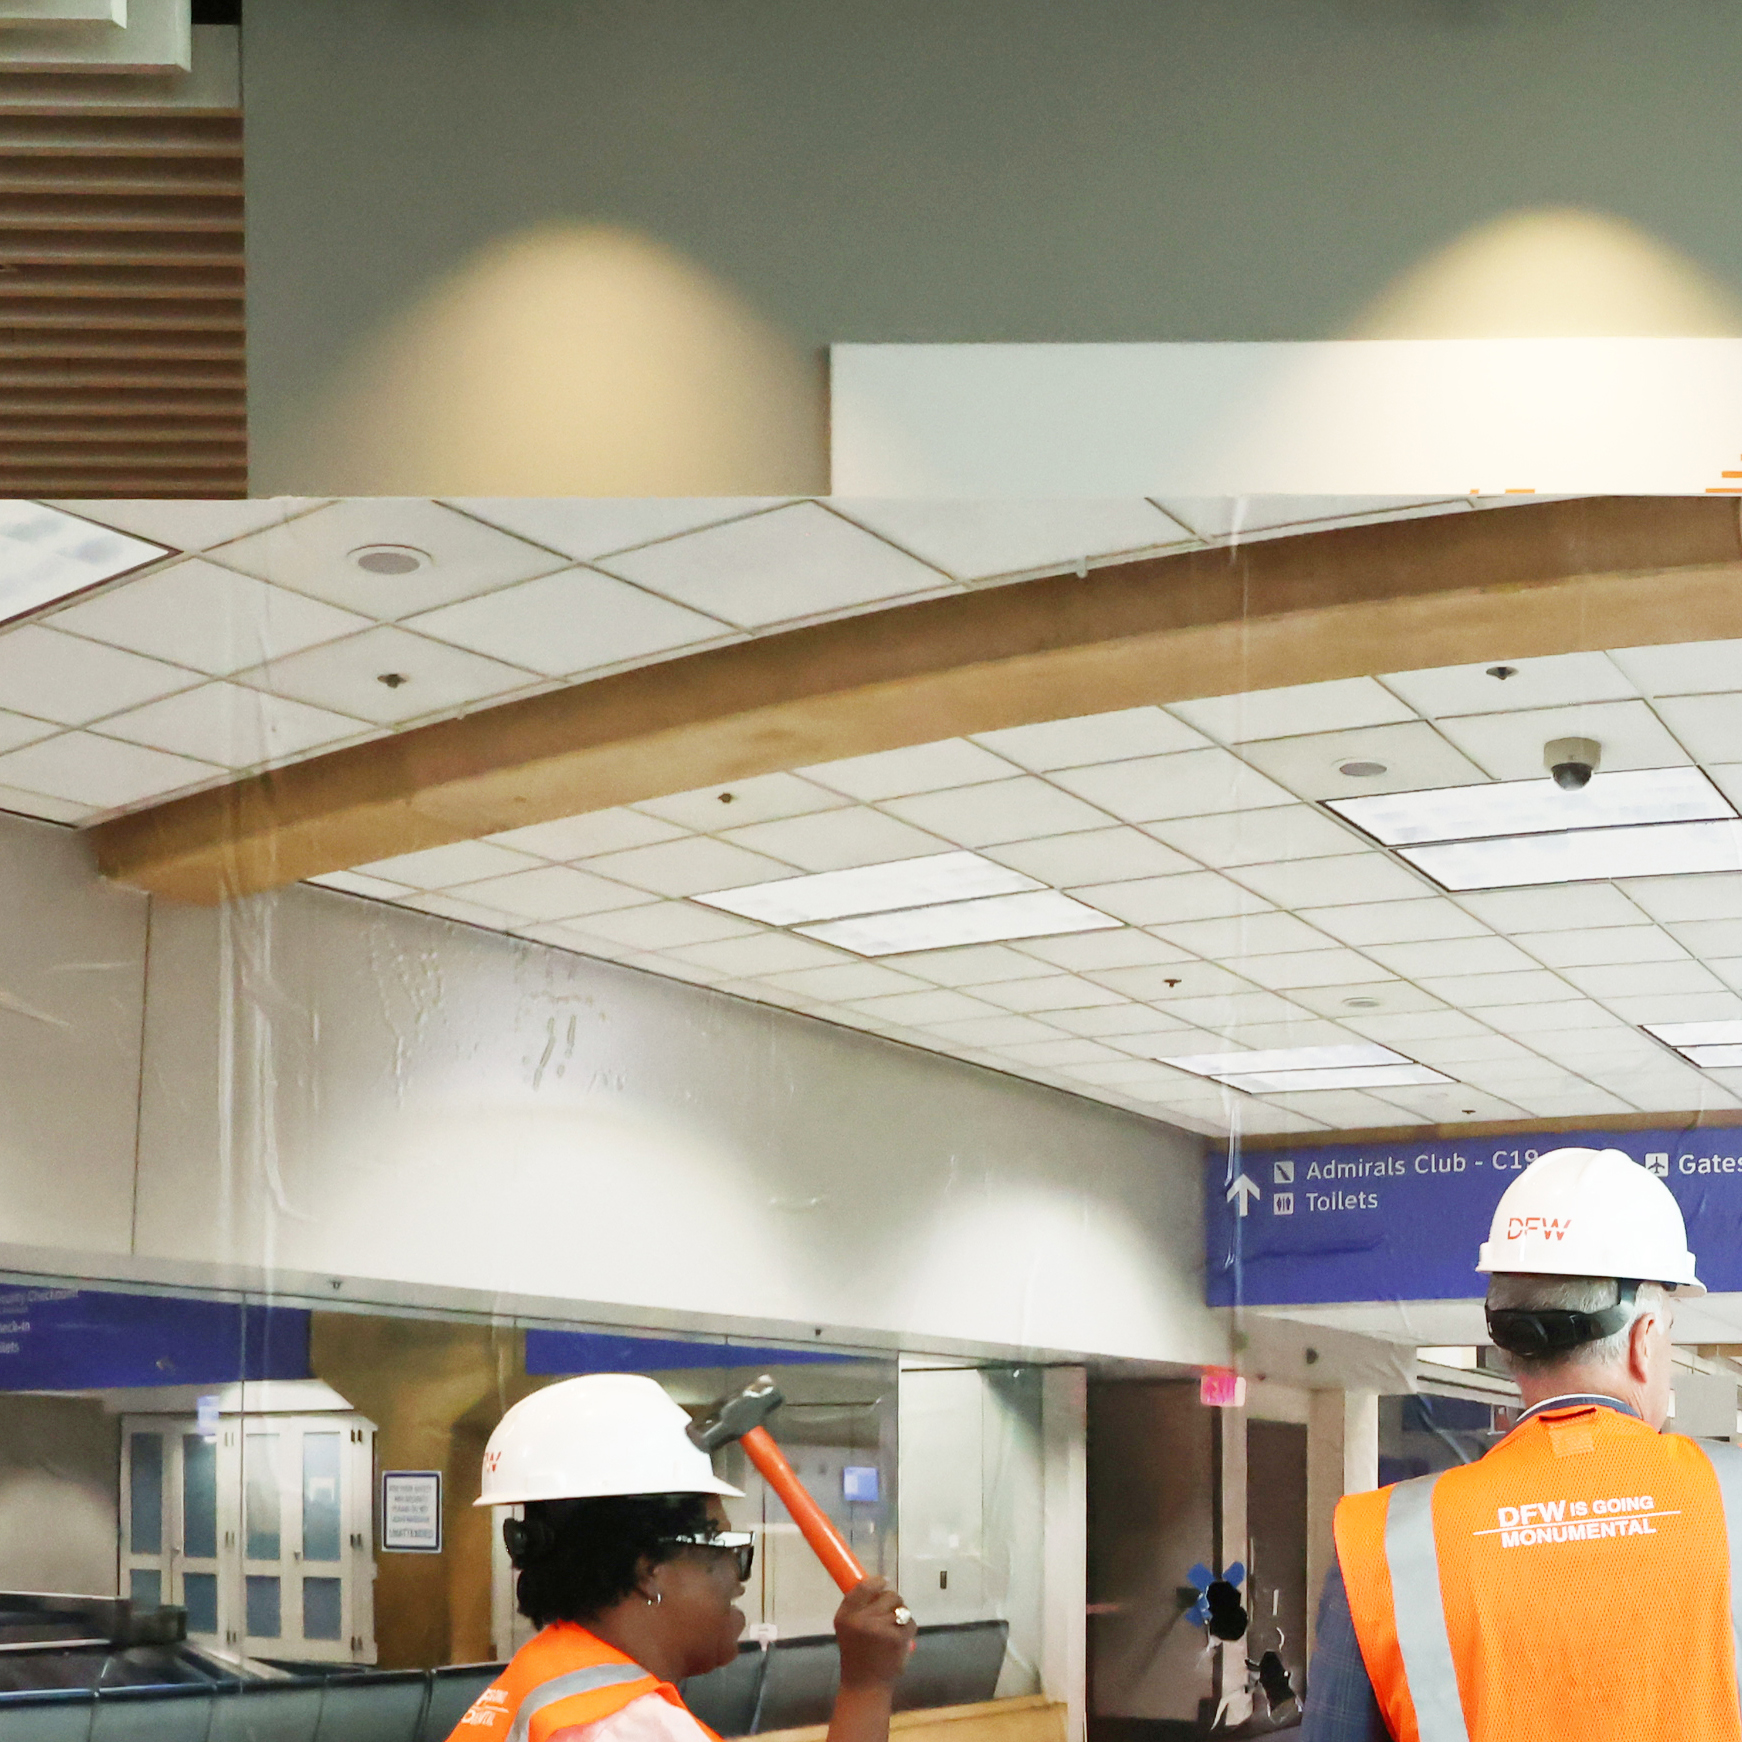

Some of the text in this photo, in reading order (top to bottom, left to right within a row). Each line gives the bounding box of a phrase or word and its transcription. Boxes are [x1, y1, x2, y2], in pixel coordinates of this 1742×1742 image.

[1306, 1157, 1405, 1180] Admirals
[1414, 1152, 1466, 1174] Club
[1306, 1191, 1378, 1212] Toilets
[1507, 1217, 1572, 1241] DFW
[1498, 1495, 1655, 1528] DFW IS GOING
[1501, 1518, 1657, 1548] MONUMENTAL
